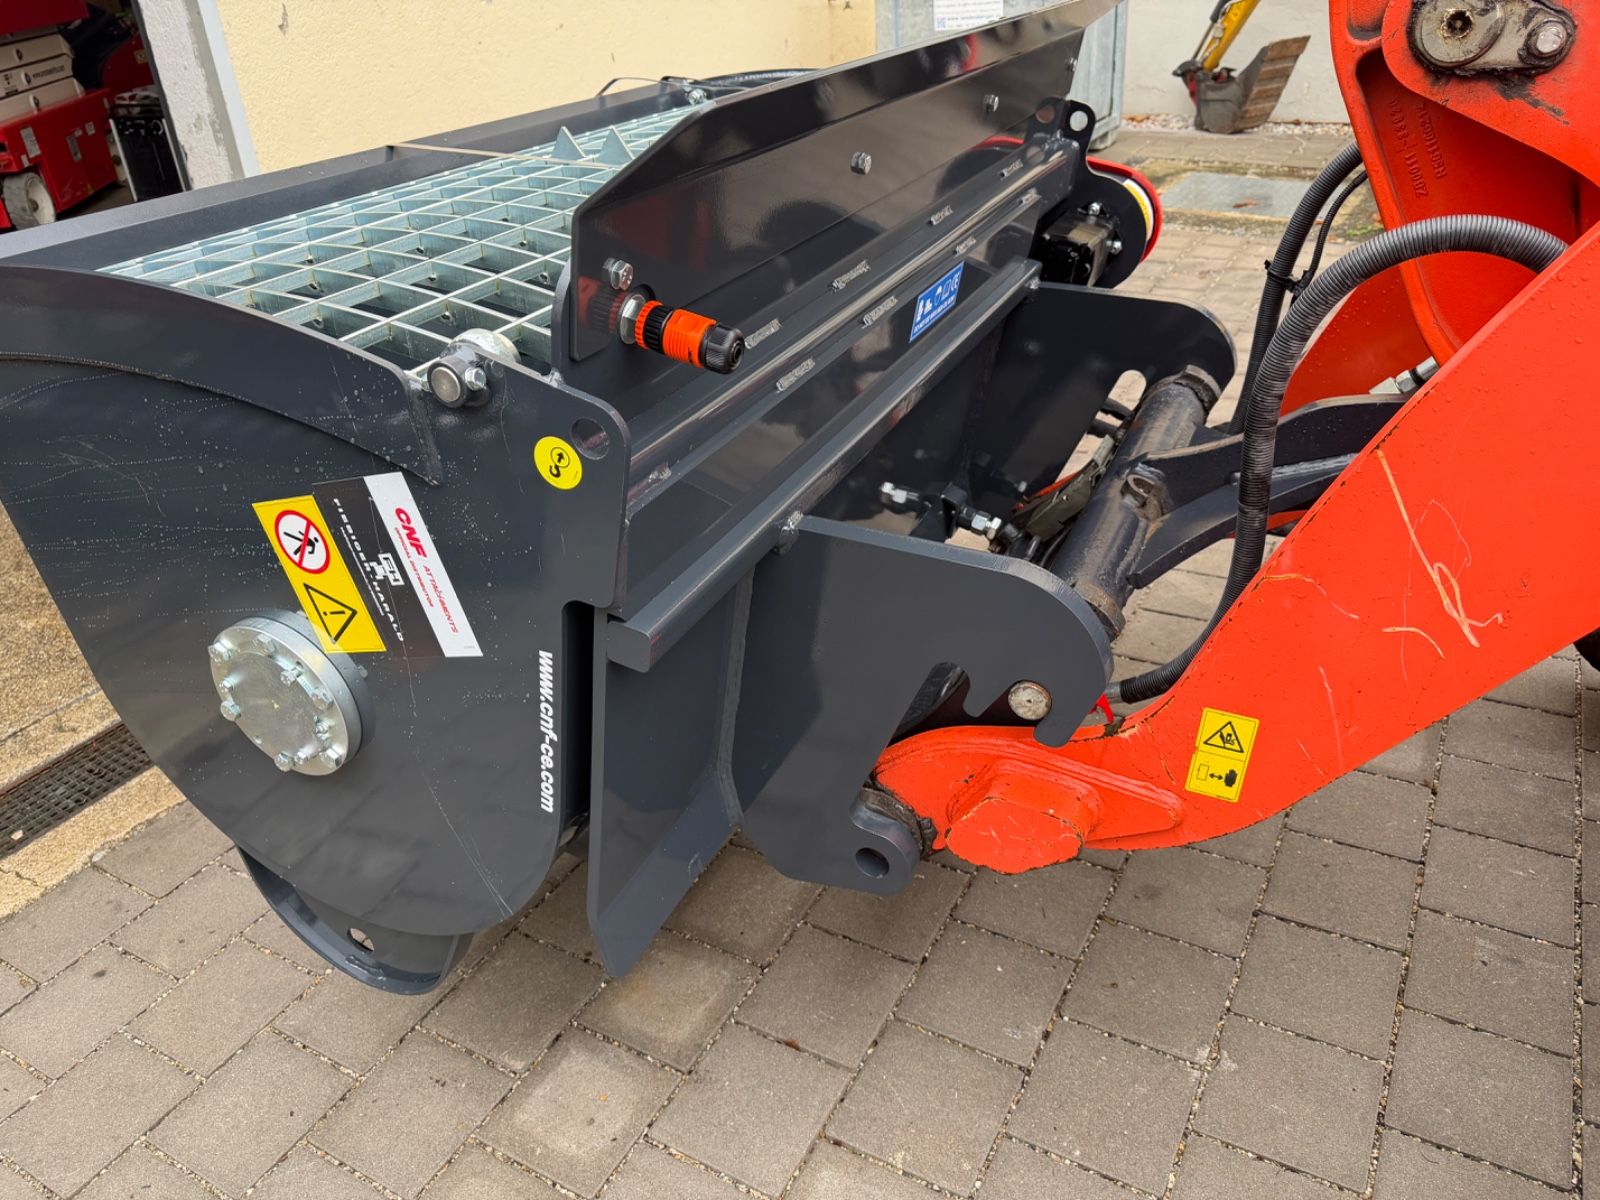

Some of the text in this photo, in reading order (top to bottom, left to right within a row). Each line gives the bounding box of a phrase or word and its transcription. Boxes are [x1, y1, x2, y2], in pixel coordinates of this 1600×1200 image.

[393, 507, 459, 635] CNF ATTACHMENTS
[394, 527, 435, 608] OFFICIAL DISTRIBUTOR
[538, 650, 558, 813] www.cnf-ce.com
